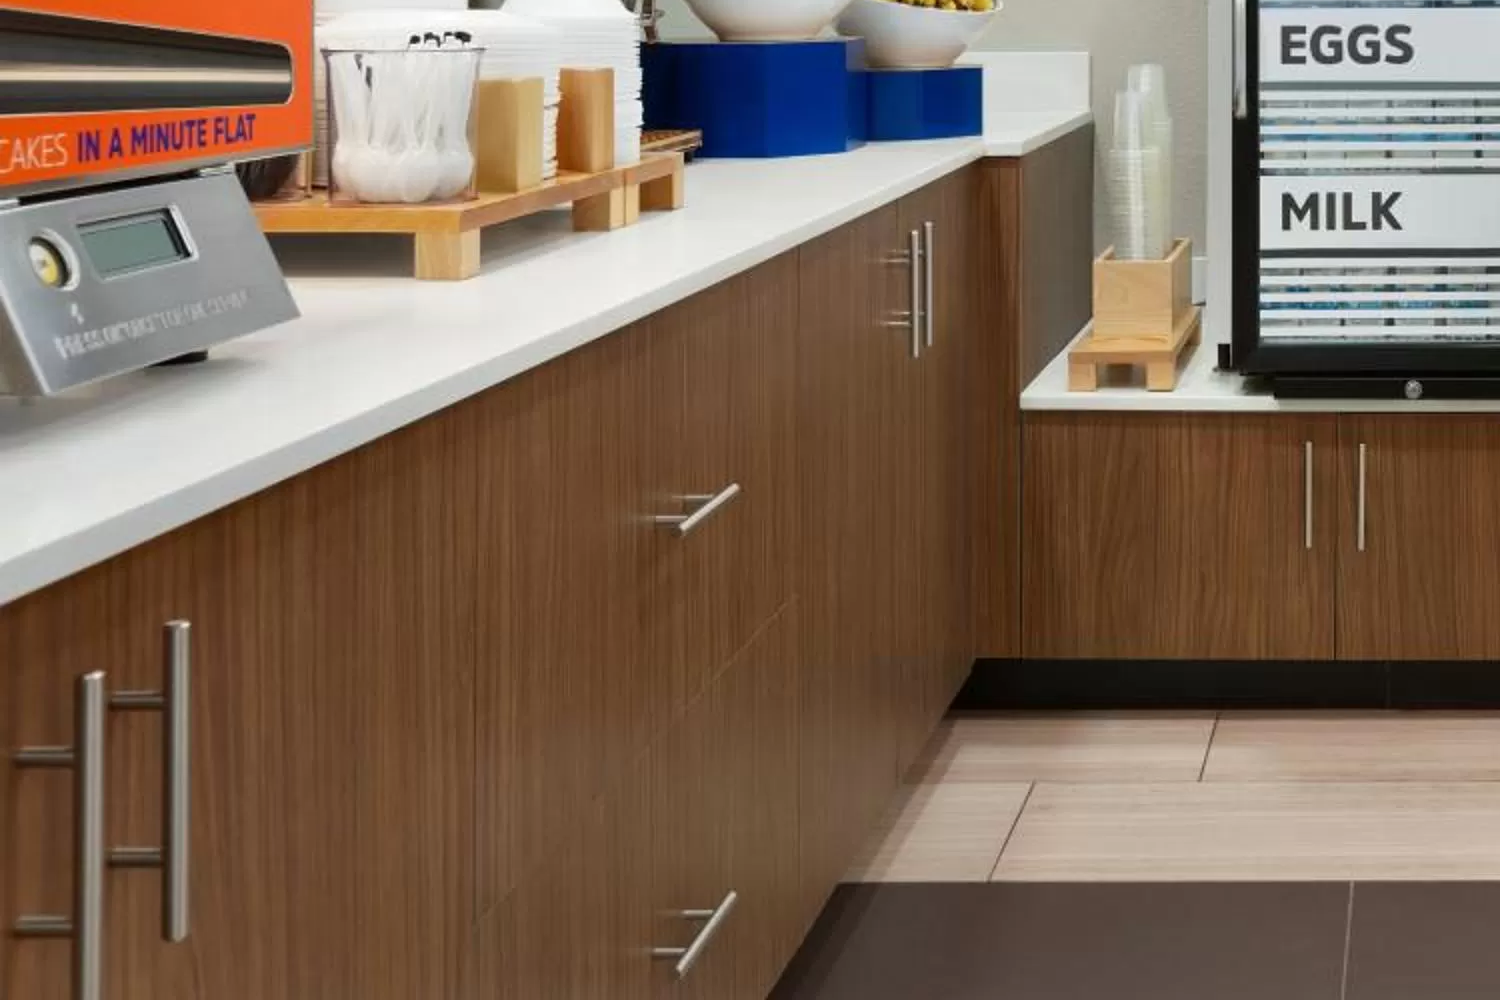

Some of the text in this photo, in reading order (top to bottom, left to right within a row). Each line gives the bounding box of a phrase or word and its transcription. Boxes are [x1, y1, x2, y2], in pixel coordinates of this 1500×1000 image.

[1280, 24, 1415, 66] EGGS
[77, 130, 101, 163] IN
[108, 127, 123, 159] A
[130, 118, 208, 156] MINUTE
[212, 113, 256, 146] FLAT
[1280, 191, 1403, 231] MILK
